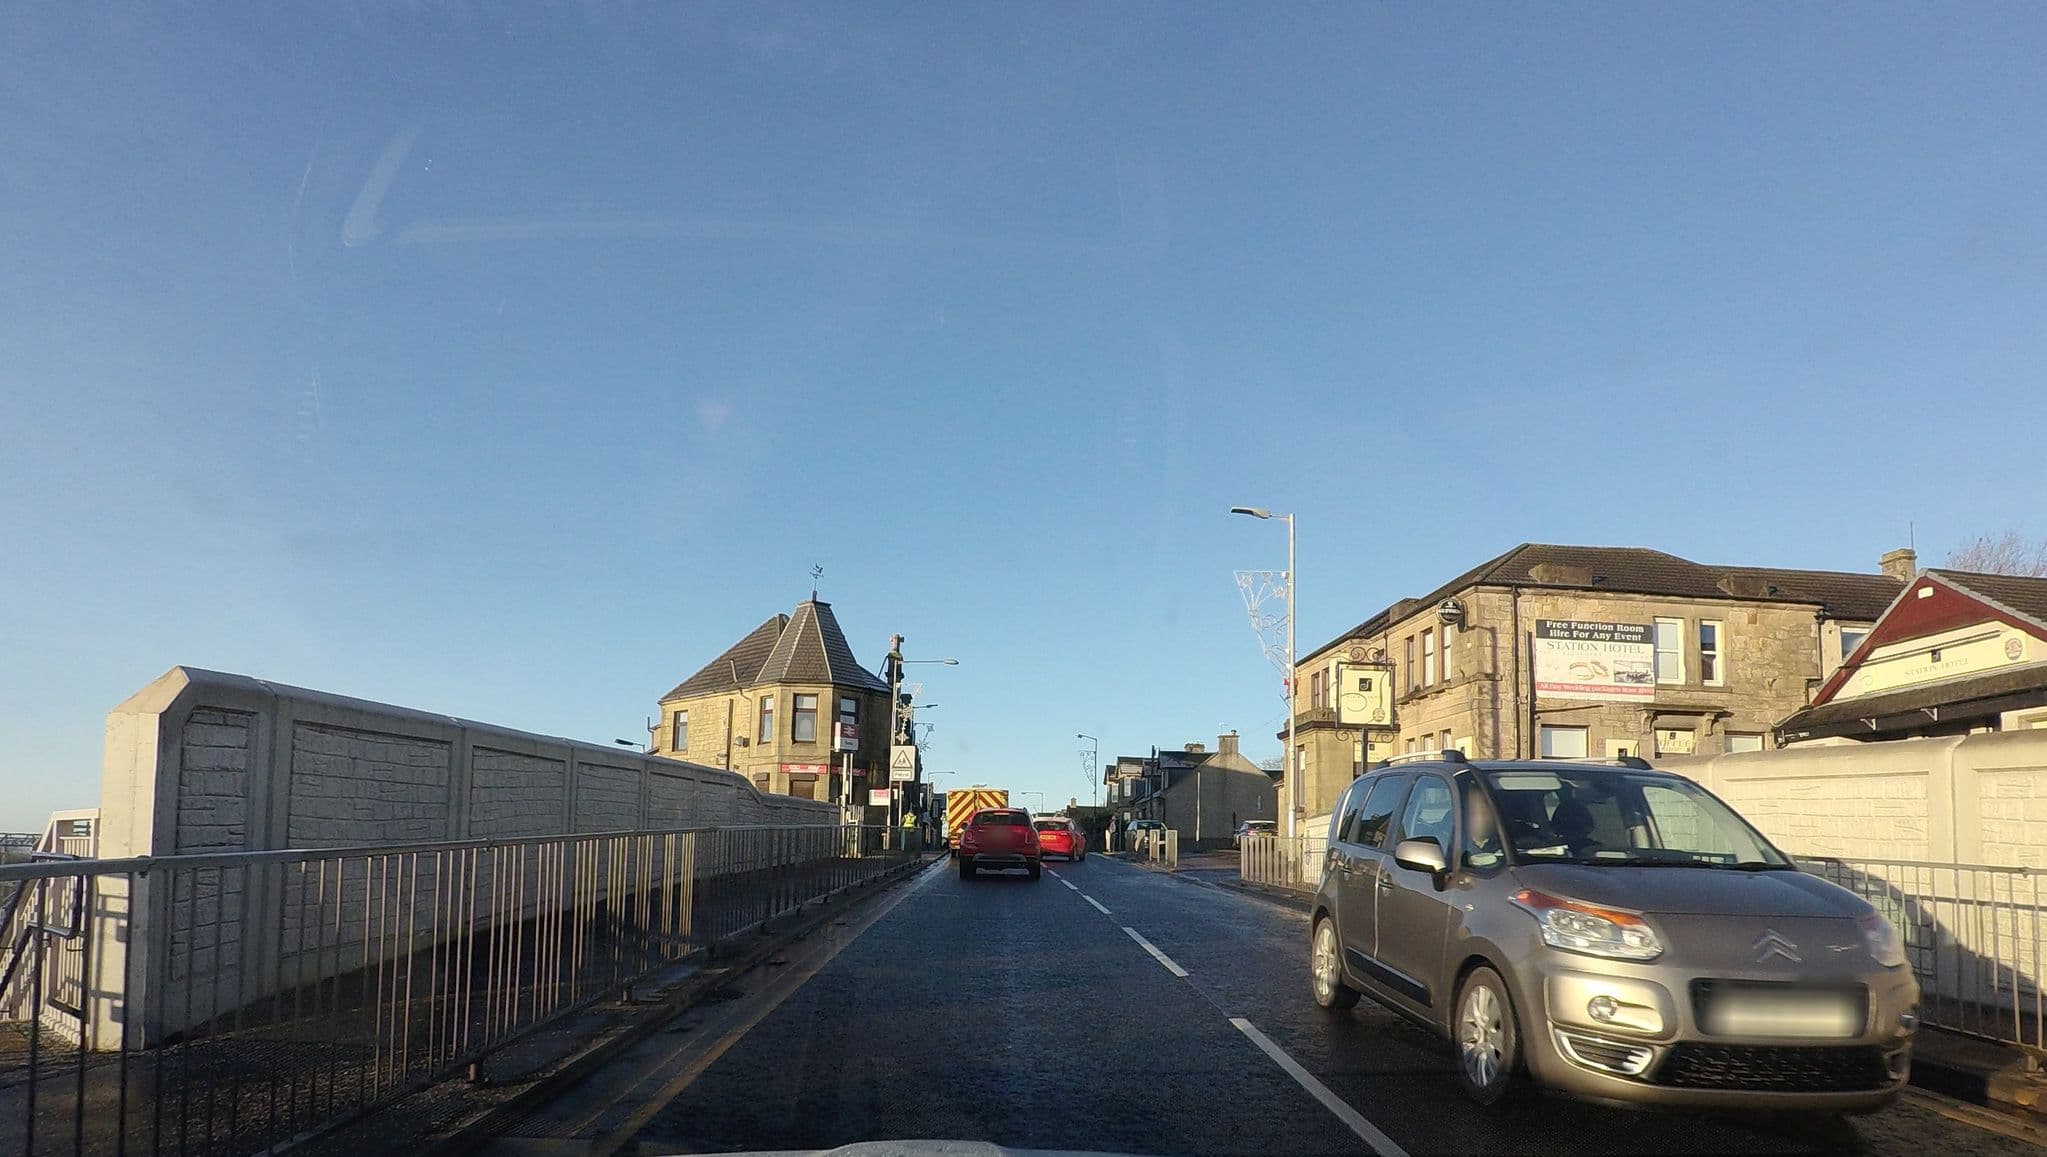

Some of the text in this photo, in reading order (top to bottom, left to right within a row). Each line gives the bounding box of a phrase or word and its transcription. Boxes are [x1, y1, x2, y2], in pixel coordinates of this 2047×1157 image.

[1546, 620, 1644, 633] Free Function Room
[1549, 629, 1642, 641] Hire For Any Event
[1546, 641, 1645, 653] STATION HOTEL
